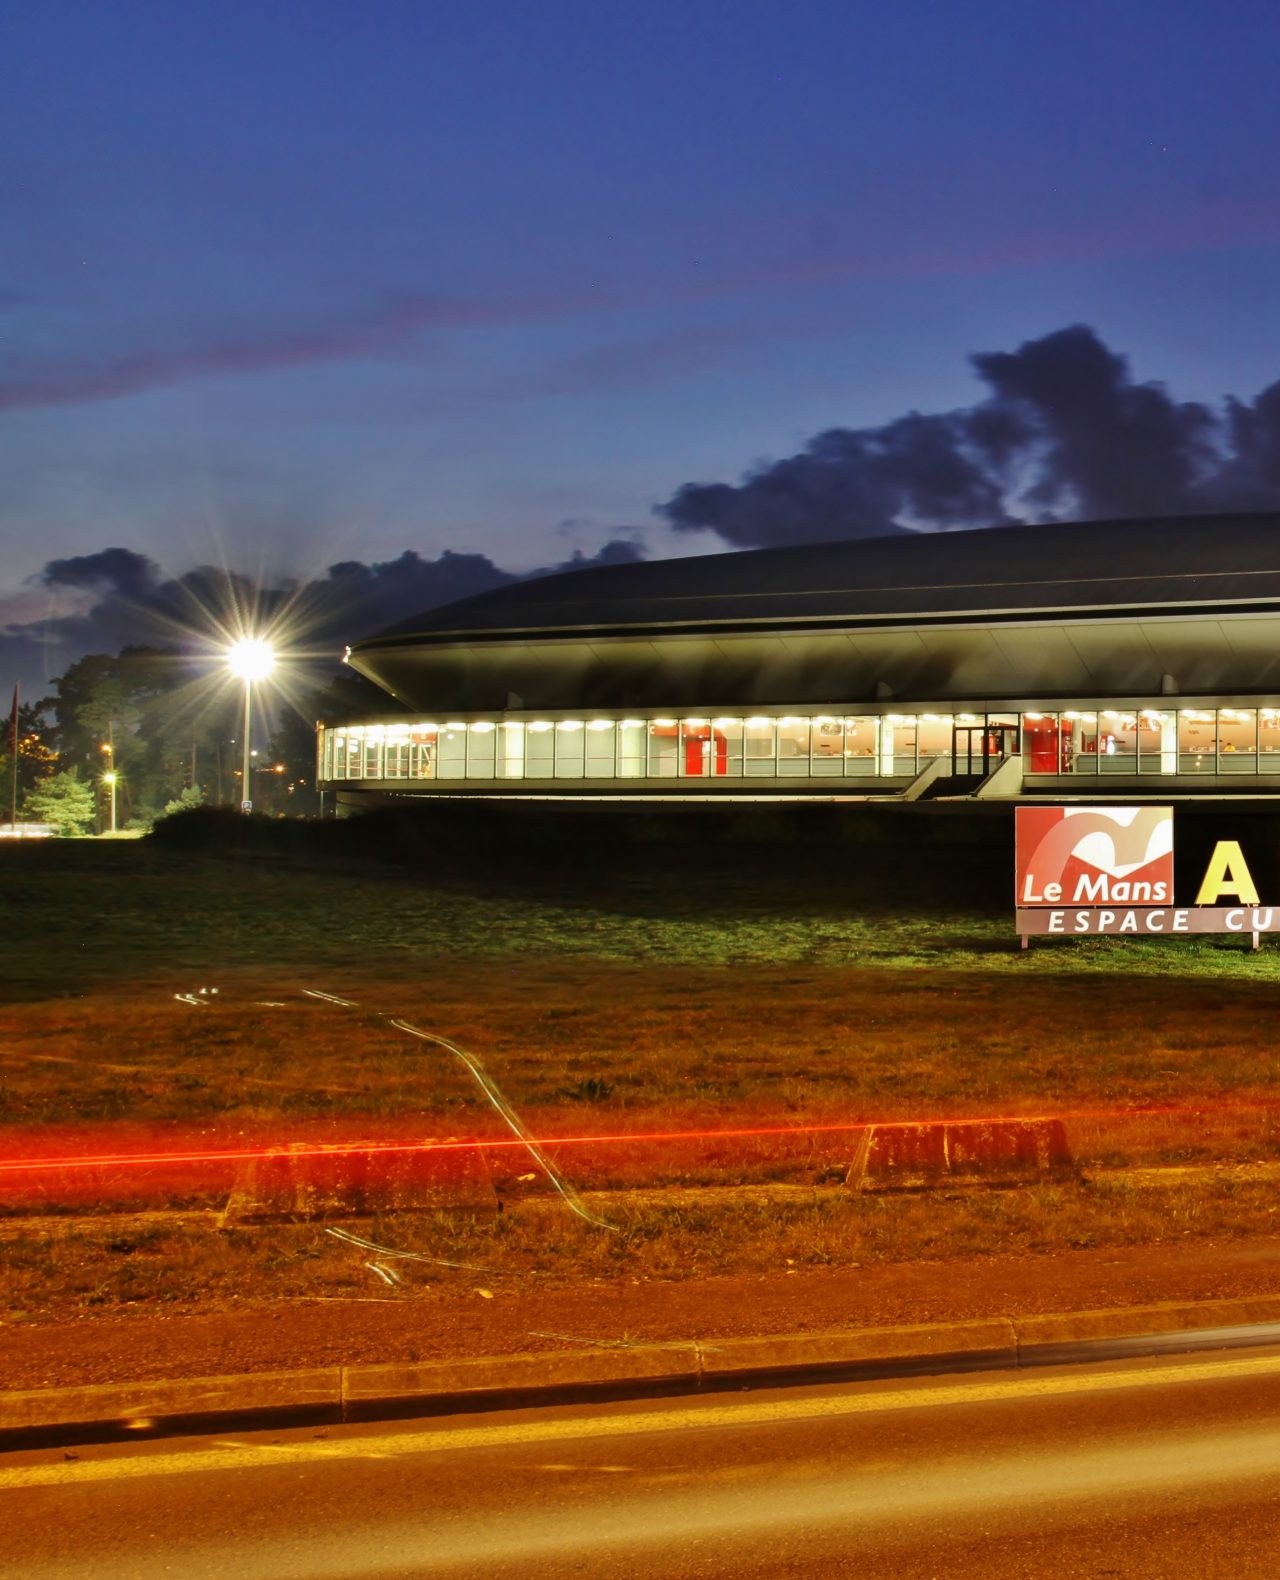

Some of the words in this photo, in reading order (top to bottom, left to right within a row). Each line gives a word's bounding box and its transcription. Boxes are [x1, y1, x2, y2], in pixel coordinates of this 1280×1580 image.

[1023, 874, 1062, 902] Le
[1072, 873, 1167, 902] Mans
[1048, 909, 1190, 933] ESPACE
